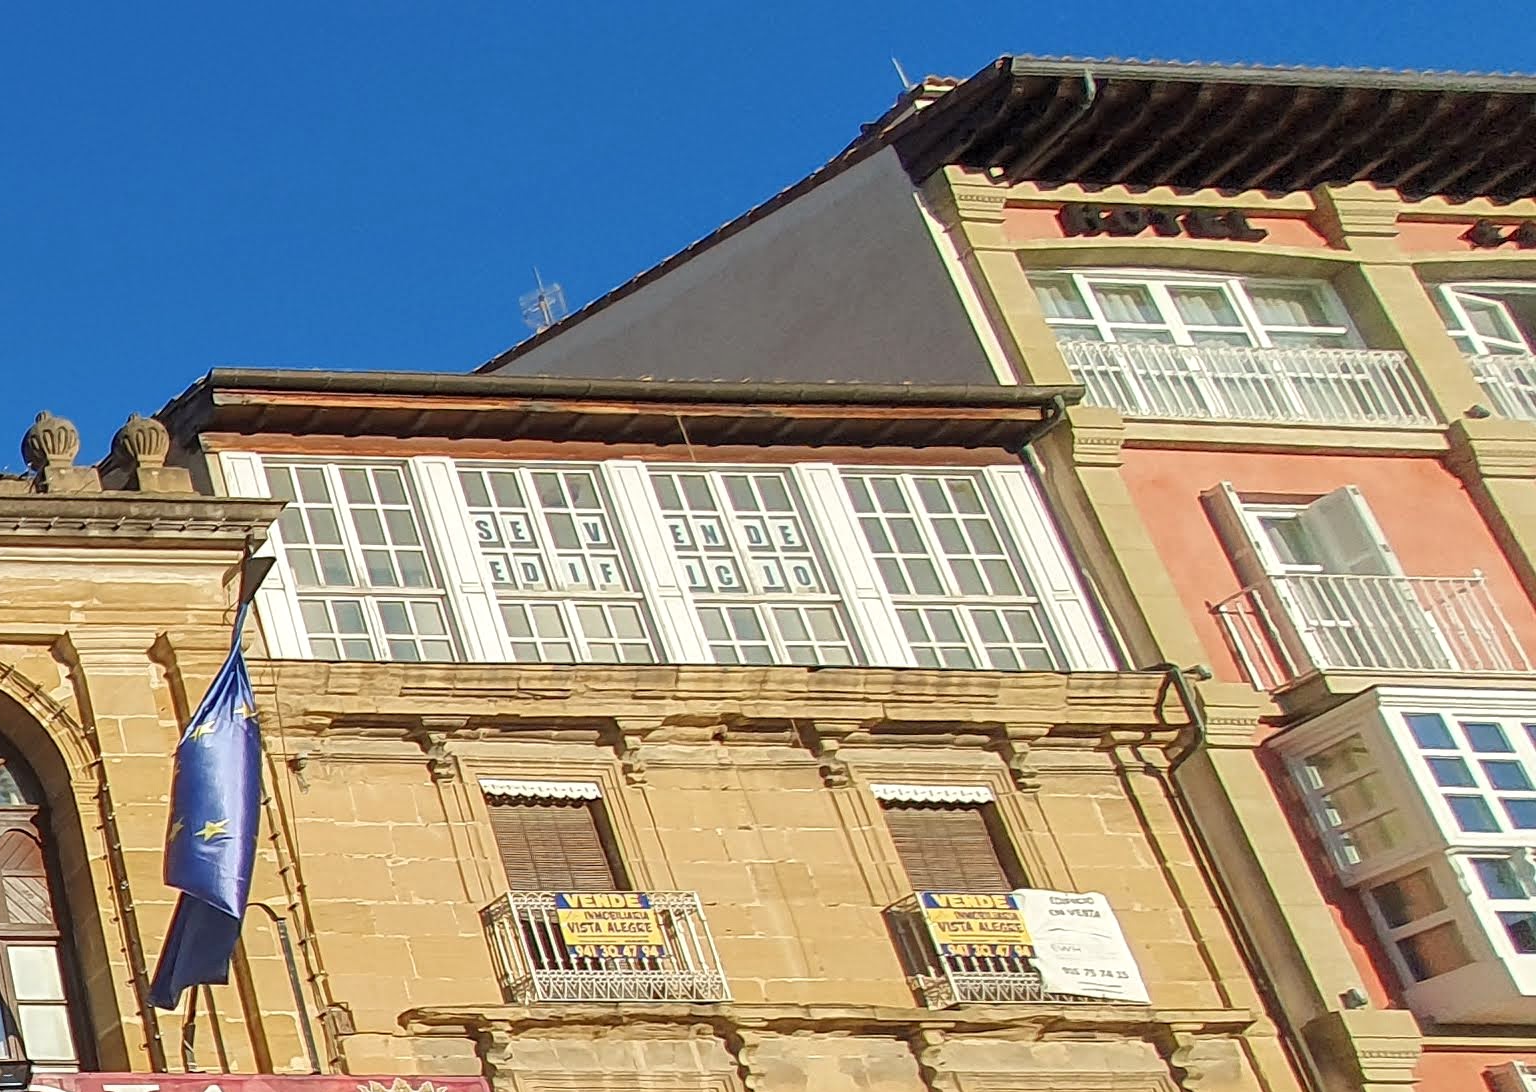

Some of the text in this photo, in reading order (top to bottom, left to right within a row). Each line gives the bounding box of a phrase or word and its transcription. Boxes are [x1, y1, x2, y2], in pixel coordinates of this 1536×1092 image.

[474, 519, 526, 541] SE
[563, 893, 642, 908] VENDE
[931, 893, 1011, 908] VENDE
[567, 922, 653, 933] VISTA ALEGRE
[937, 921, 973, 932] VISTA
